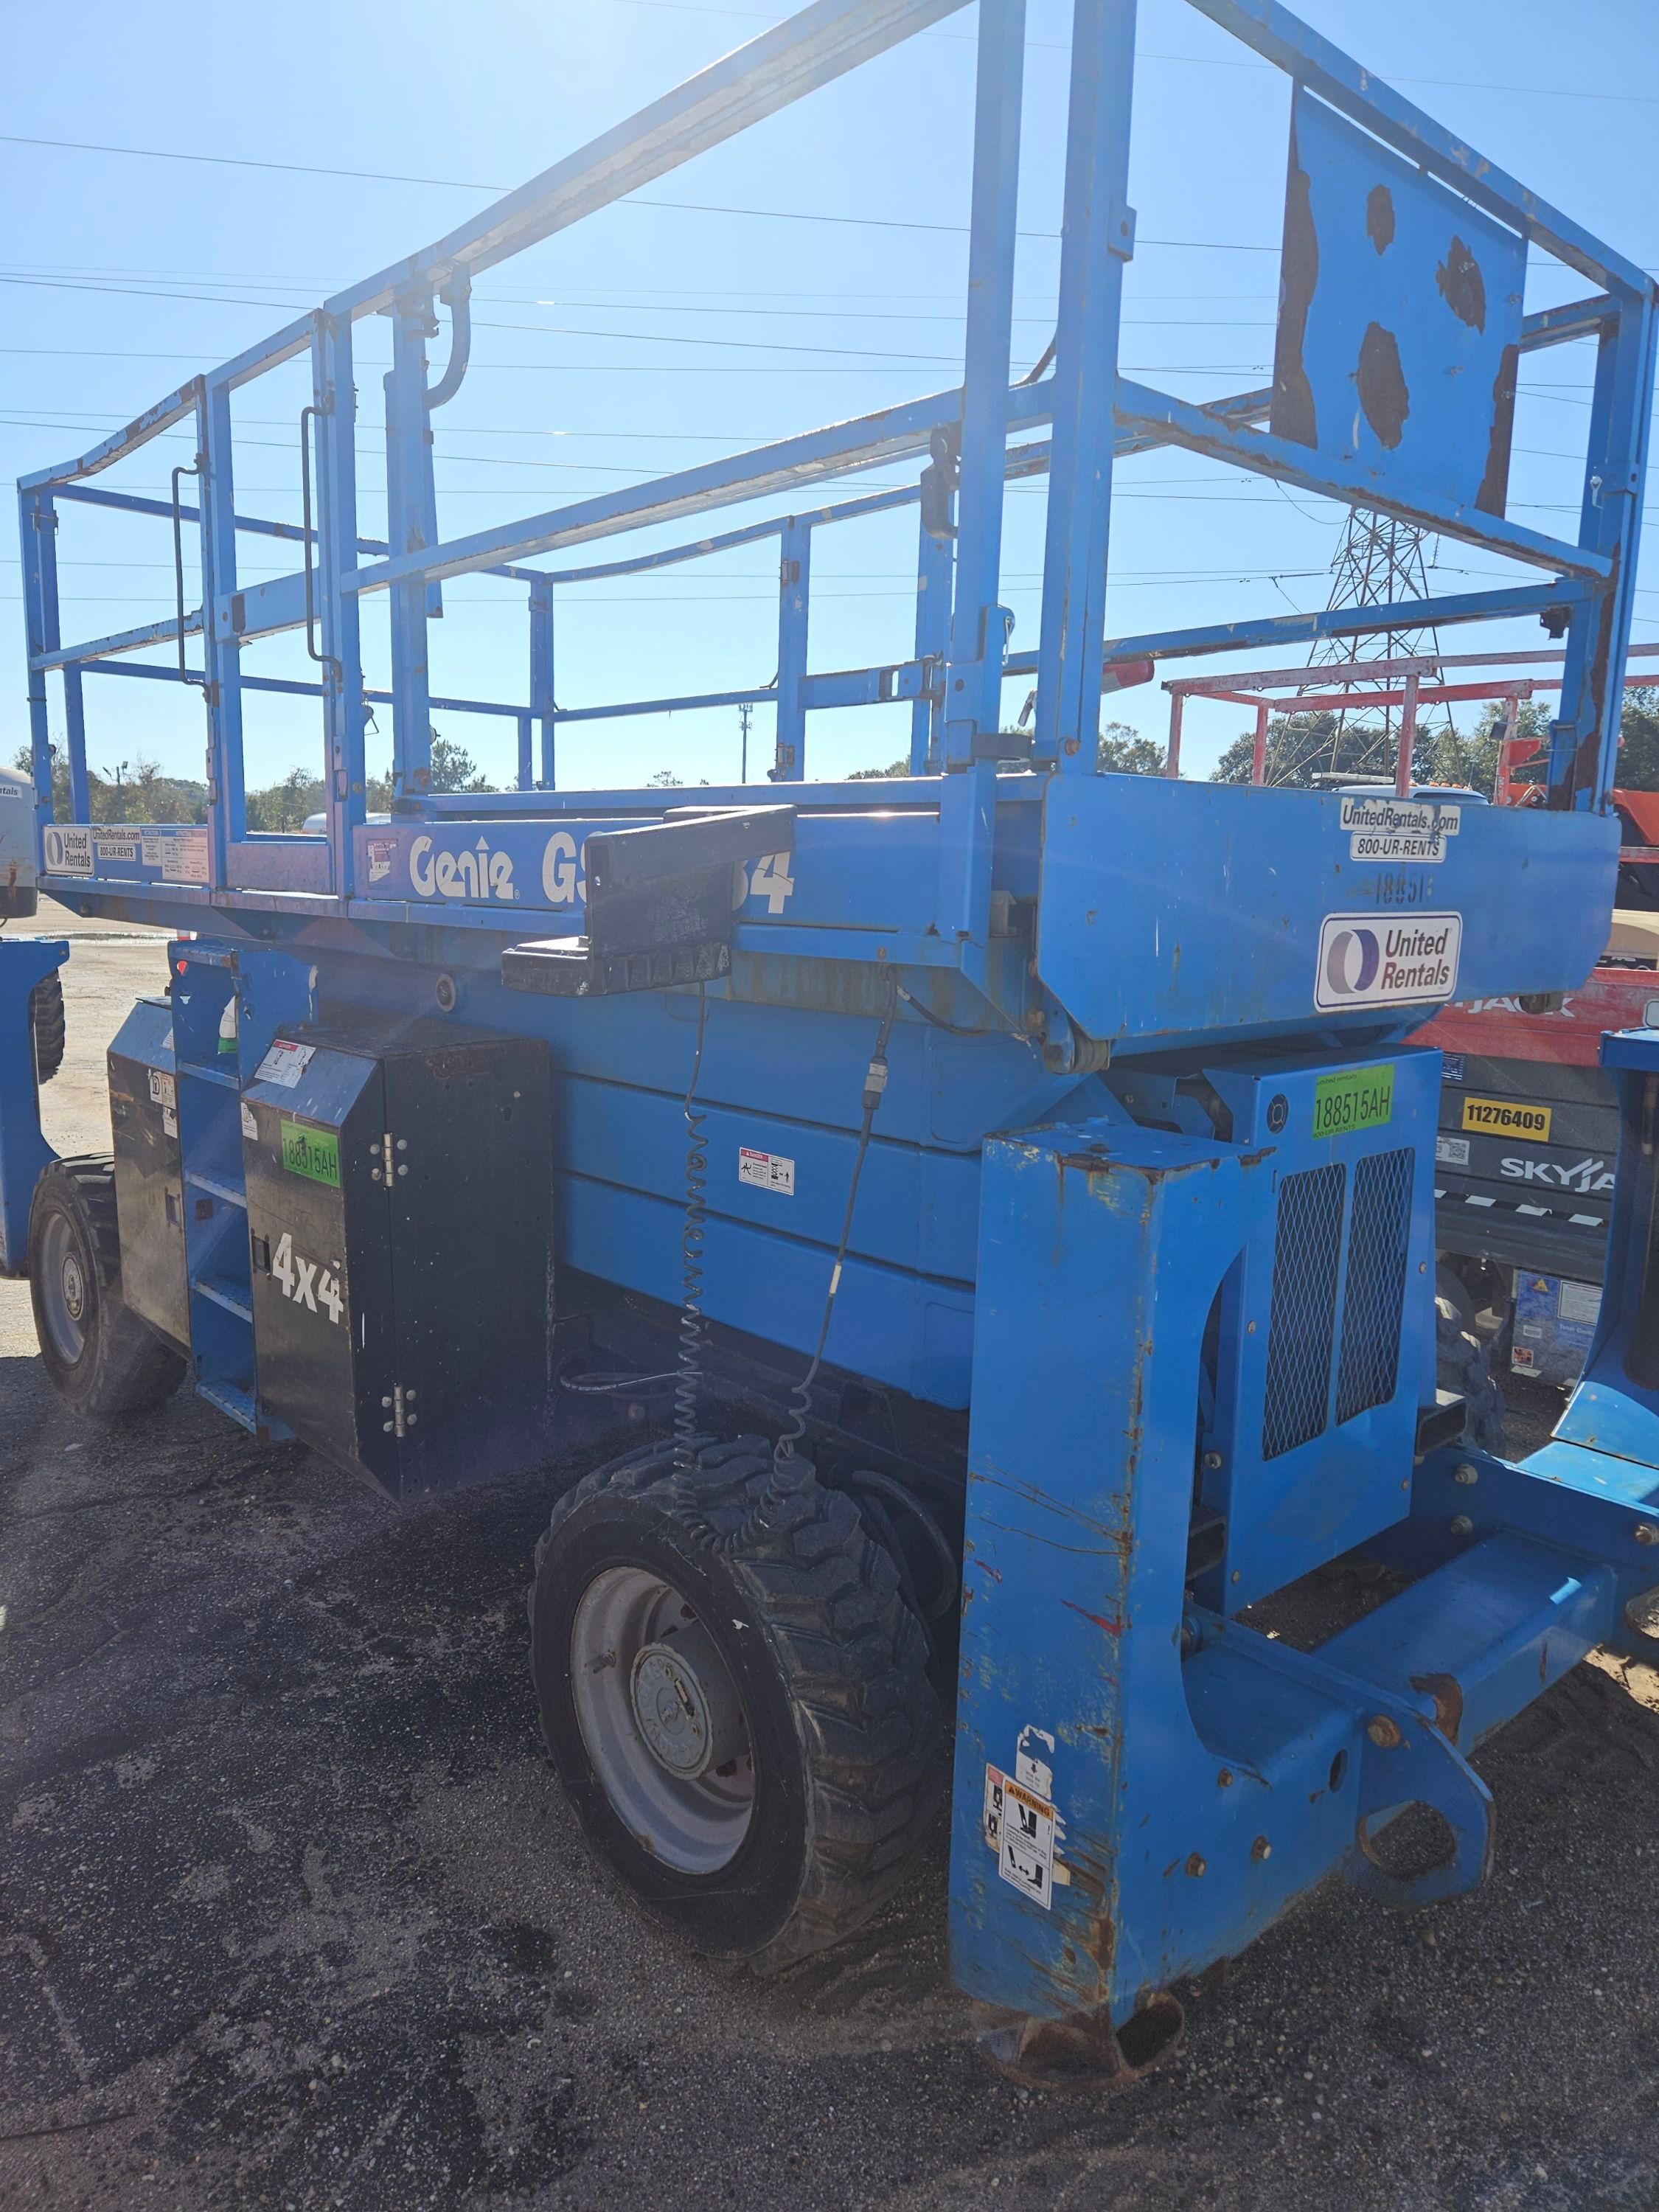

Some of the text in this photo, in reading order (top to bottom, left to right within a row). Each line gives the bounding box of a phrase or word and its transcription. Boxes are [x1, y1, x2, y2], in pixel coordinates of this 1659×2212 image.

[63, 832, 87, 849] United
[93, 829, 140, 841] UnitedRentals.com
[1357, 838, 1439, 856] 800-UR-RENTS
[65, 850, 90, 867] Rentals
[100, 846, 133, 857] 800-UR-RENTS
[409, 835, 514, 899] Genie
[1385, 928, 1448, 958] United
[1380, 959, 1450, 990] Rentals
[1316, 1085, 1391, 1130] 188515AH
[1467, 1105, 1545, 1130] 11276409
[1015, 1788, 1051, 1817] WARNING
